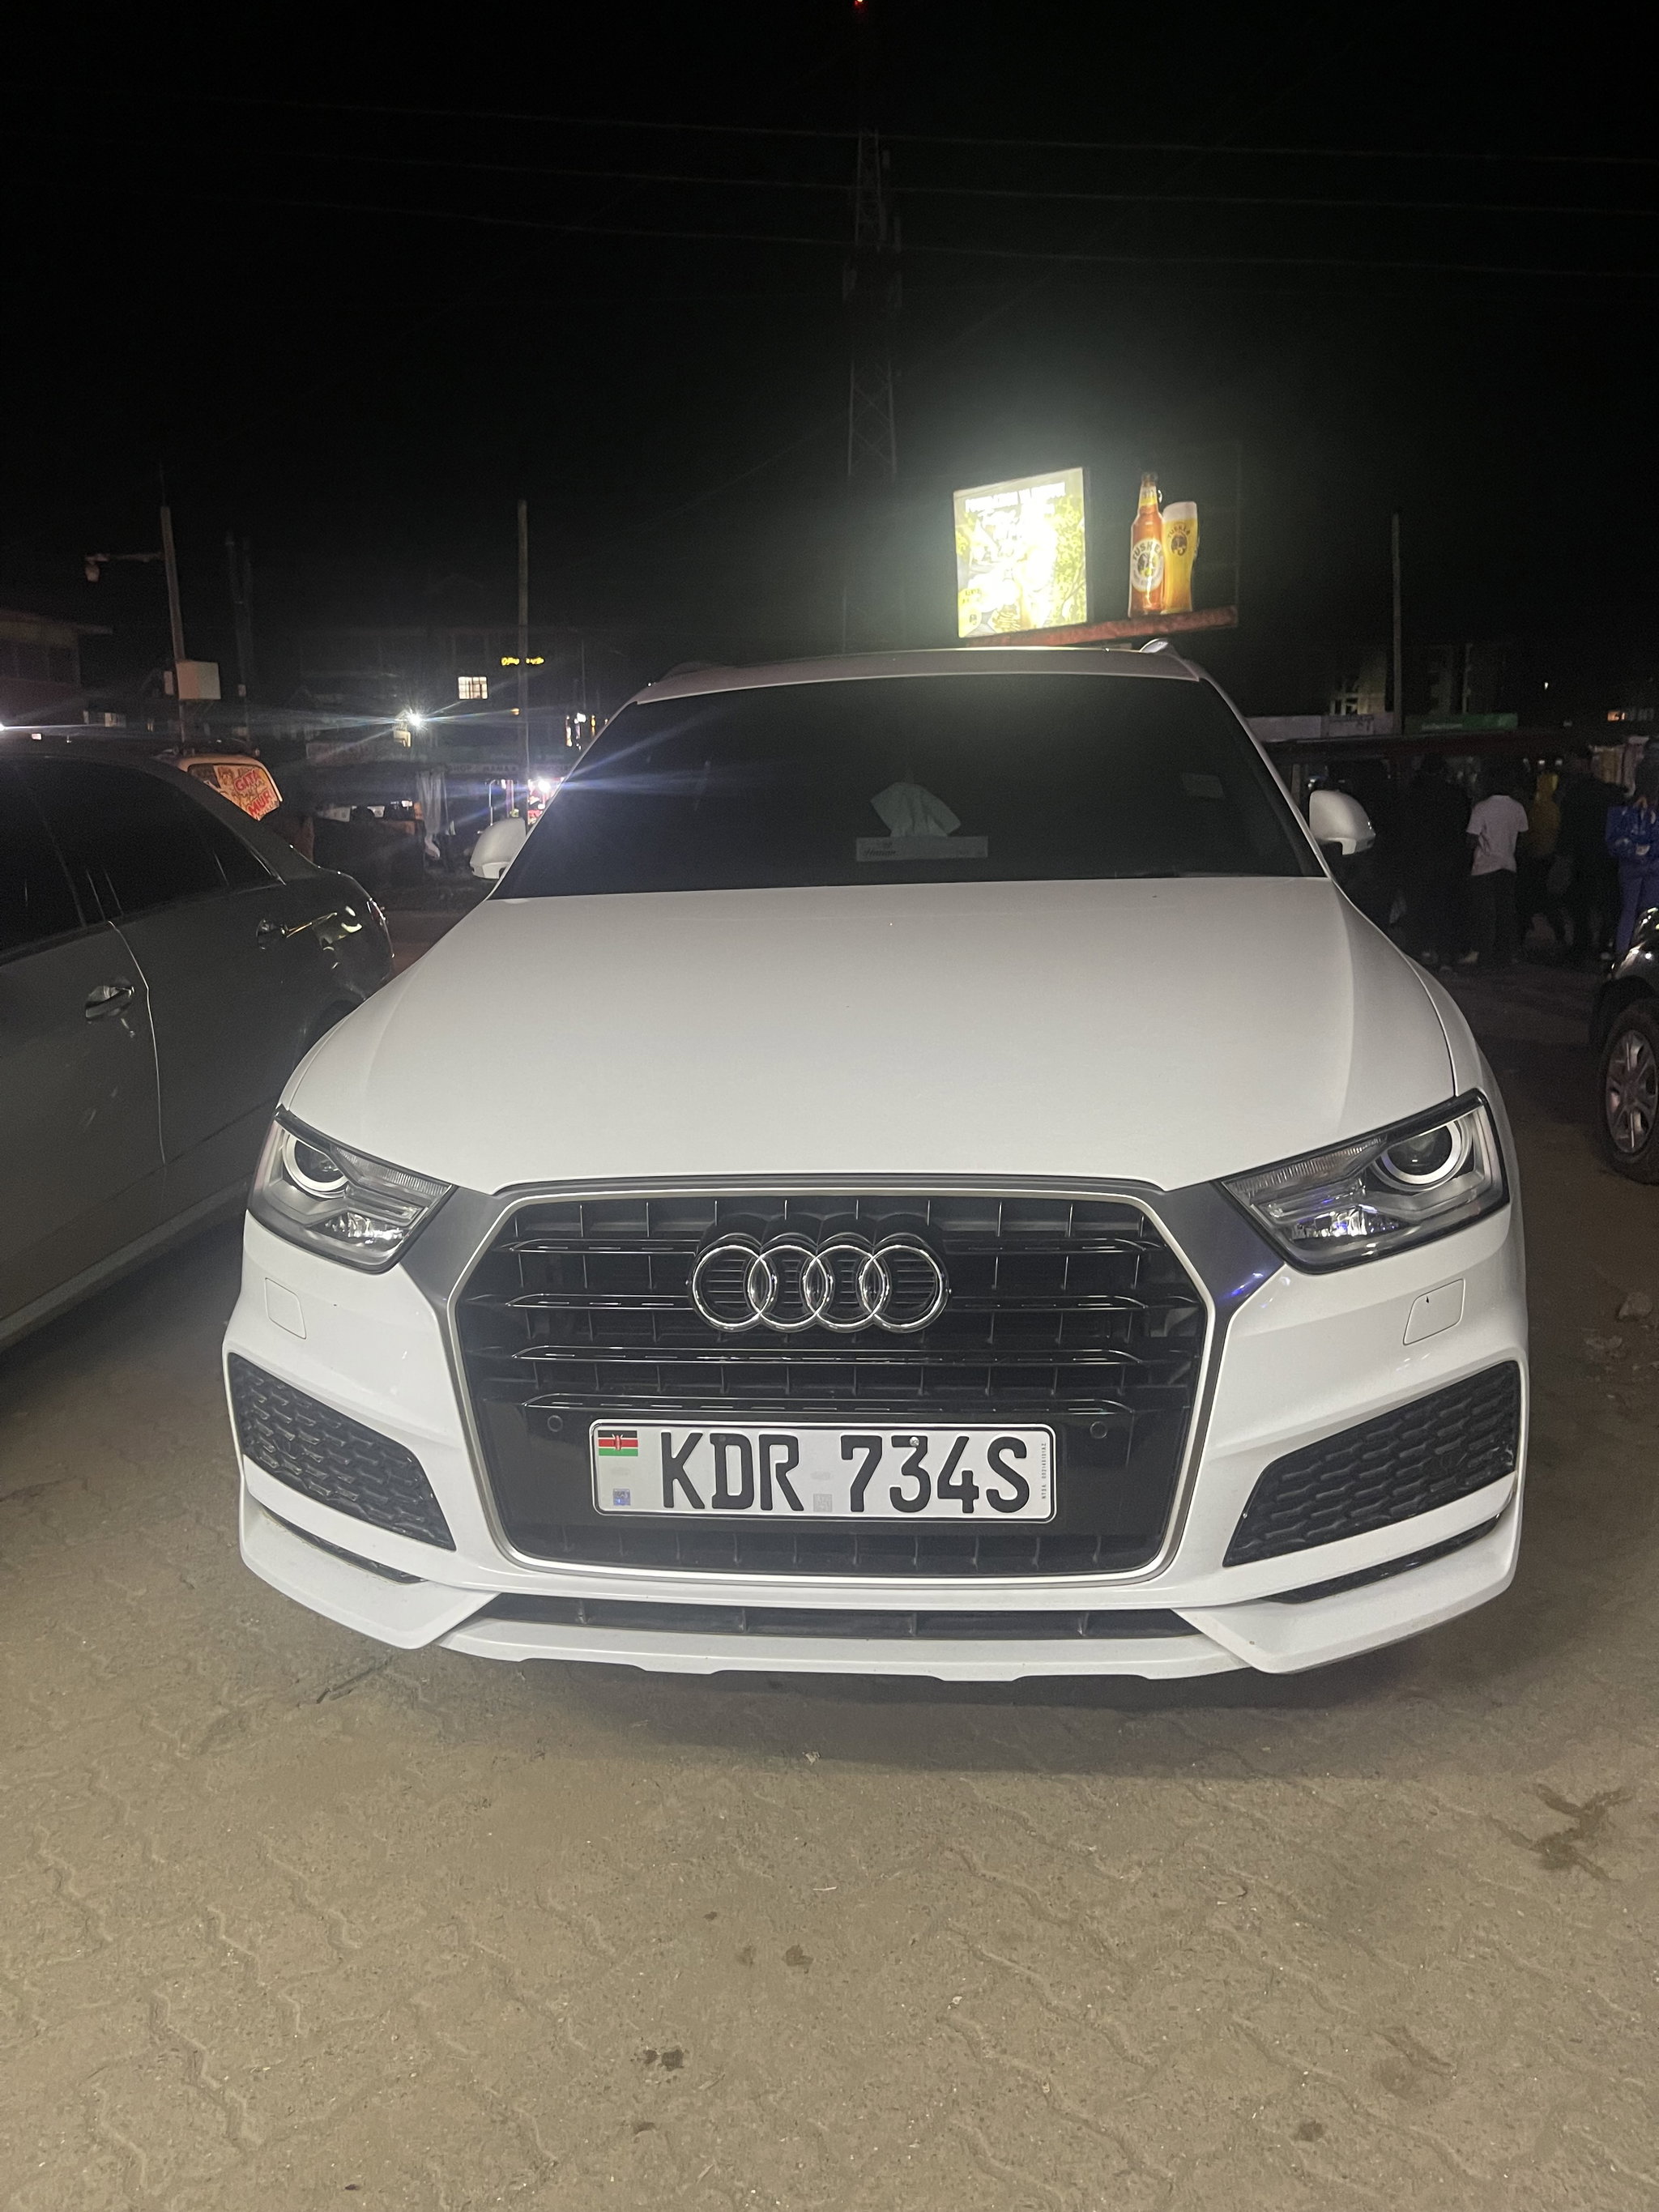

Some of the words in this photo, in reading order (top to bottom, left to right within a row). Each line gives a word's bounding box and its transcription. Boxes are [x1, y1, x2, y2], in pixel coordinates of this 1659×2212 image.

[1132, 540, 1163, 560] TUSKE
[660, 1431, 804, 1512] KDR
[840, 1434, 1030, 1514] 734S
